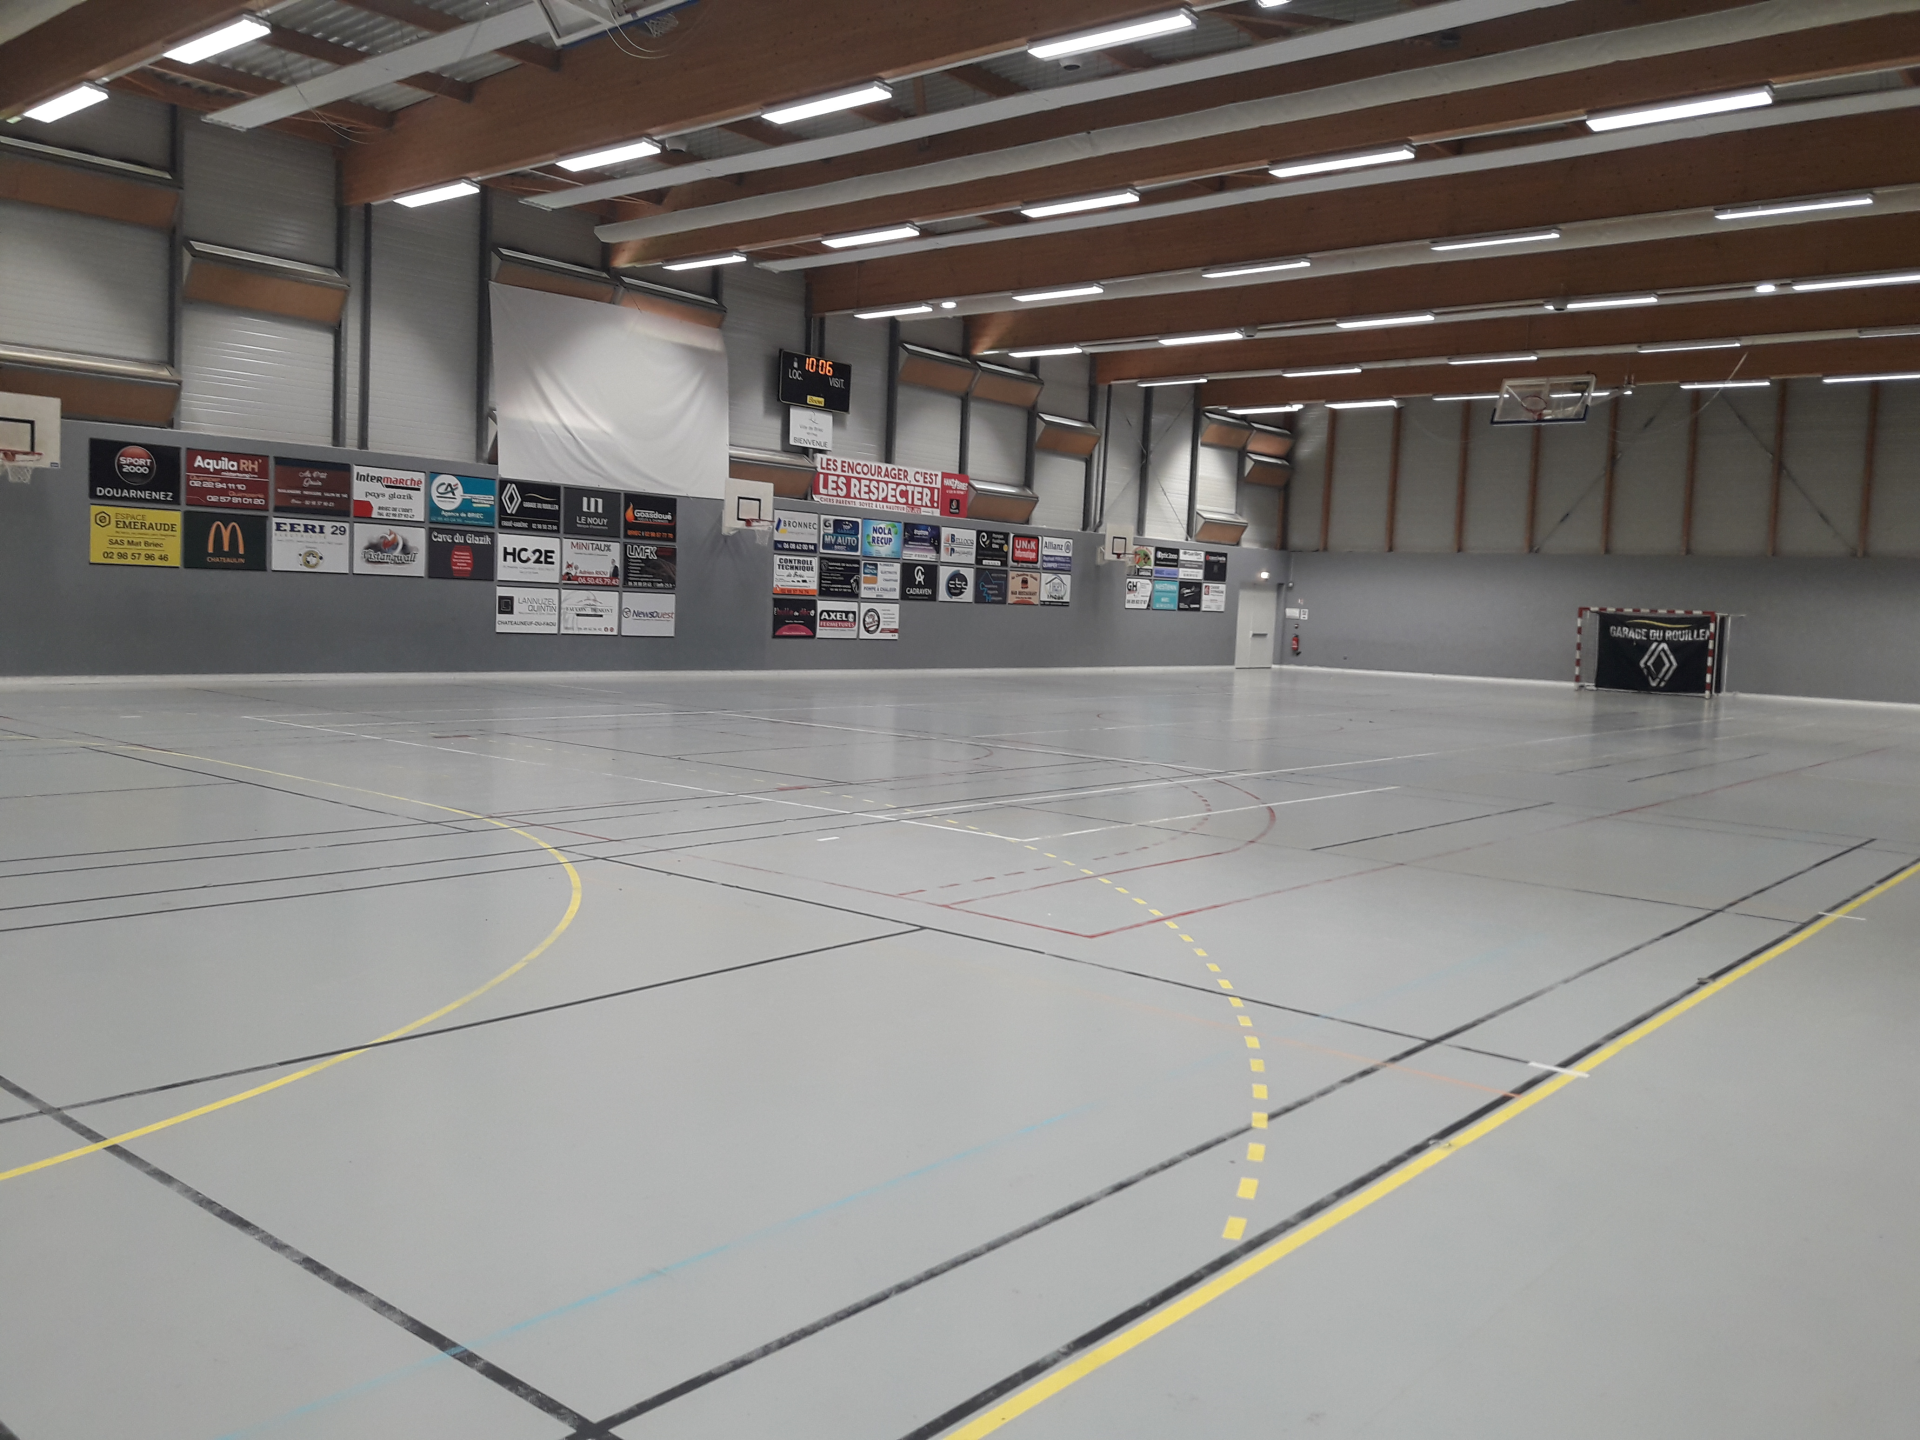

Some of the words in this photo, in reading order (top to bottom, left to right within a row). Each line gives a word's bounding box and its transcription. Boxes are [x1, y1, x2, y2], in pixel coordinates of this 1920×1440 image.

[793, 436, 828, 448] BIENVENUE
[119, 456, 152, 466] SPORT
[194, 455, 238, 473] Aquila
[122, 465, 149, 474] 2000
[820, 457, 838, 472] LES
[913, 470, 939, 486] C'EST
[818, 473, 847, 497] LES
[96, 486, 174, 501] DOUARNENEZ
[365, 491, 386, 500] pays
[388, 492, 414, 501] glazik
[858, 501, 874, 509] SOYEZ
[115, 513, 146, 521] ESPACE
[576, 516, 587, 524] LE
[587, 517, 608, 525] NOUY
[115, 520, 178, 533] EMERAUDE
[275, 522, 325, 534] EERI
[330, 525, 347, 536] 29
[783, 520, 817, 530] BRONNEC
[872, 526, 892, 536] NOLA
[108, 538, 126, 547] SAS
[431, 531, 452, 543] Cave
[453, 533, 465, 543] du
[466, 533, 492, 545] Glazik
[824, 534, 836, 544] MV
[837, 535, 857, 546] AUTO
[871, 536, 893, 546] RECUP
[1044, 540, 1064, 551] Allianz
[103, 551, 114, 560] 02
[131, 552, 142, 561] 57
[144, 553, 156, 562] 96
[158, 553, 169, 562] 46
[627, 544, 658, 559] LMFK
[207, 556, 245, 564] CHATEAULIN
[779, 558, 813, 566] CONTROLE
[777, 564, 814, 572] TECHNIQUE
[1126, 581, 1138, 592] GH
[517, 597, 557, 606] LANNUZEL
[527, 604, 557, 613] QUINTIN
[821, 612, 847, 620] AXEL
[1610, 625, 1647, 640] GARAGE
[1650, 629, 1663, 640] DU
